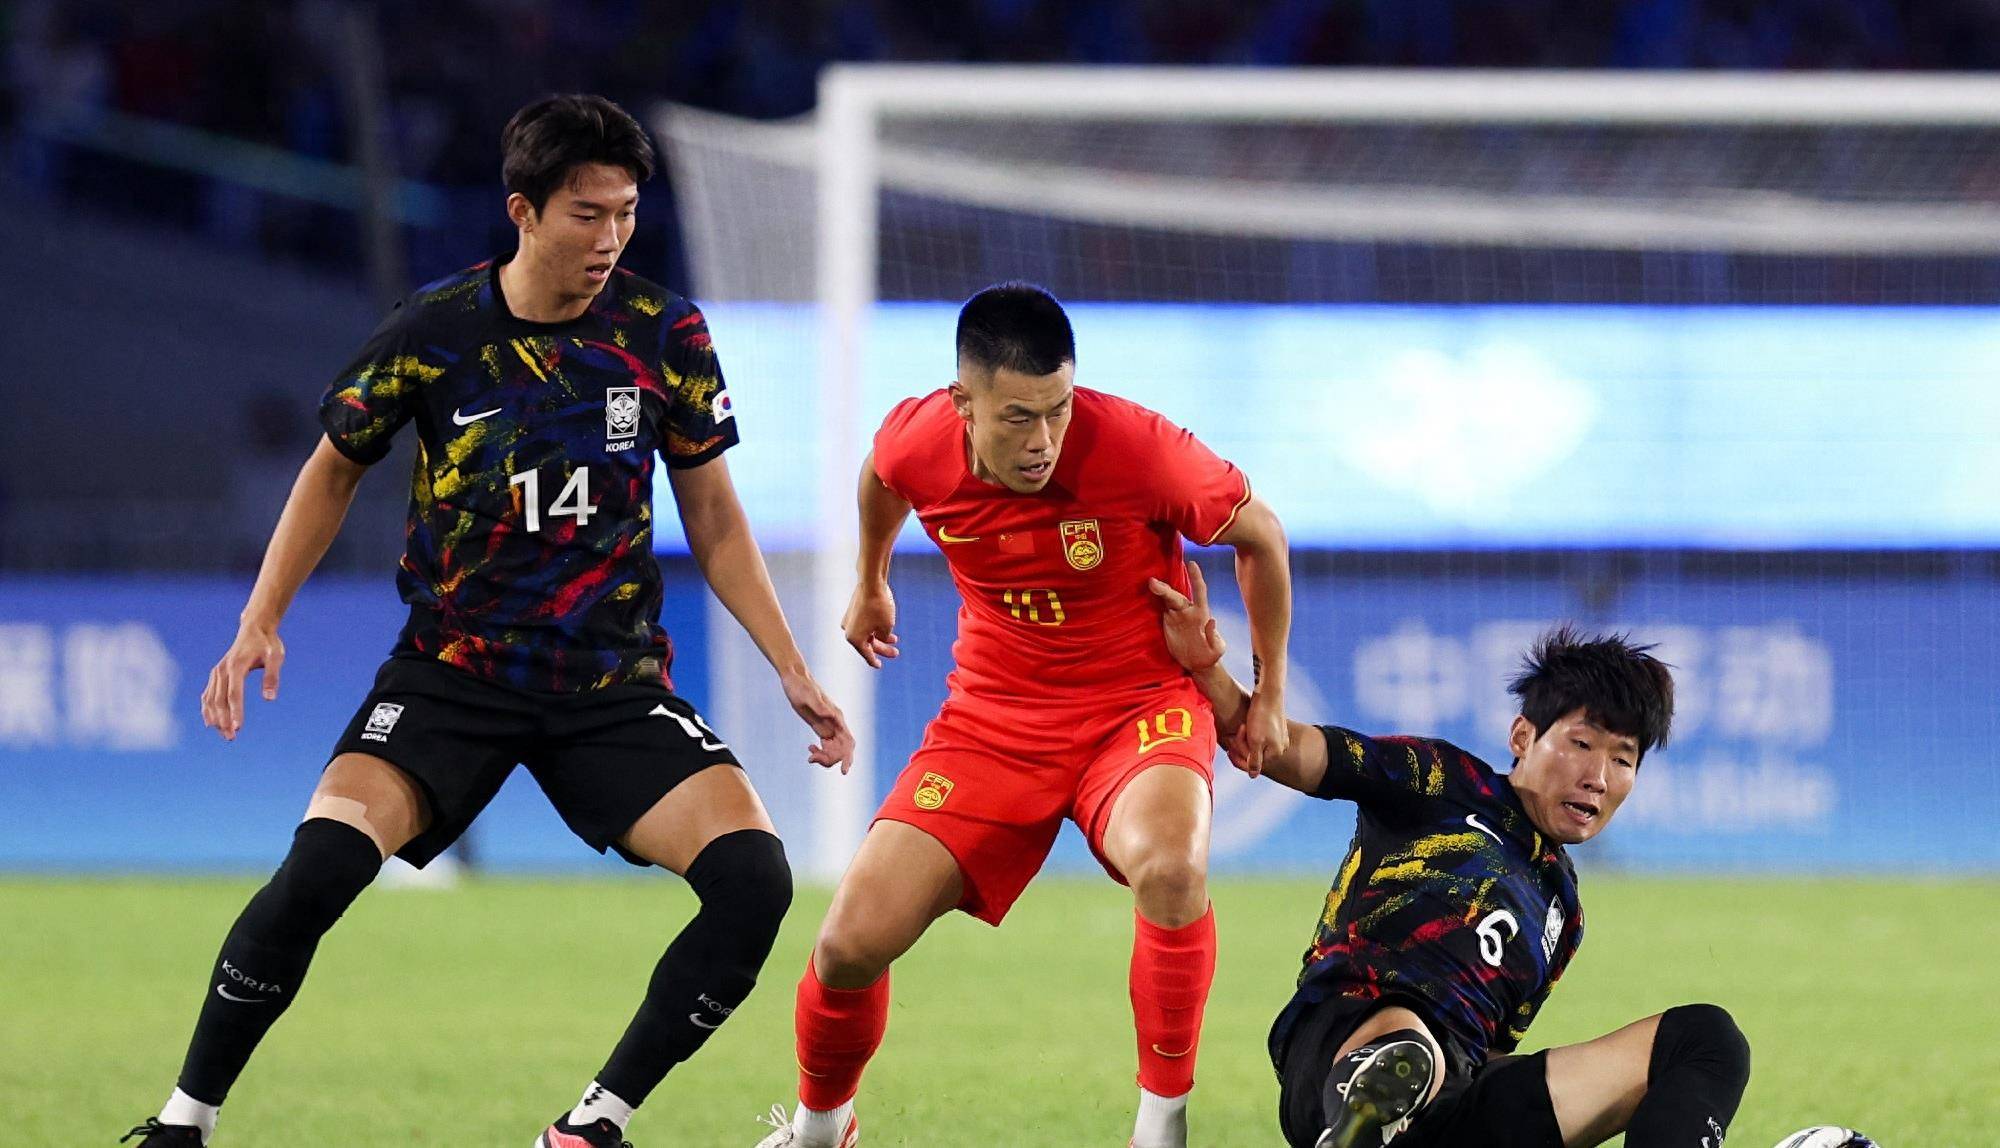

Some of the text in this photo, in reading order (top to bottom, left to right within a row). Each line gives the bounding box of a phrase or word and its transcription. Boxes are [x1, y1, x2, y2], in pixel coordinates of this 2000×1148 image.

[605, 440, 635, 452] KOREA
[509, 466, 597, 532] 14
[1064, 522, 1095, 536] CFA
[1003, 588, 1066, 626] 10
[360, 733, 388, 742] KOREA
[1136, 707, 1193, 744] 10
[925, 773, 951, 790] CFA
[1475, 909, 1520, 967] 6
[221, 959, 282, 993] KOREA
